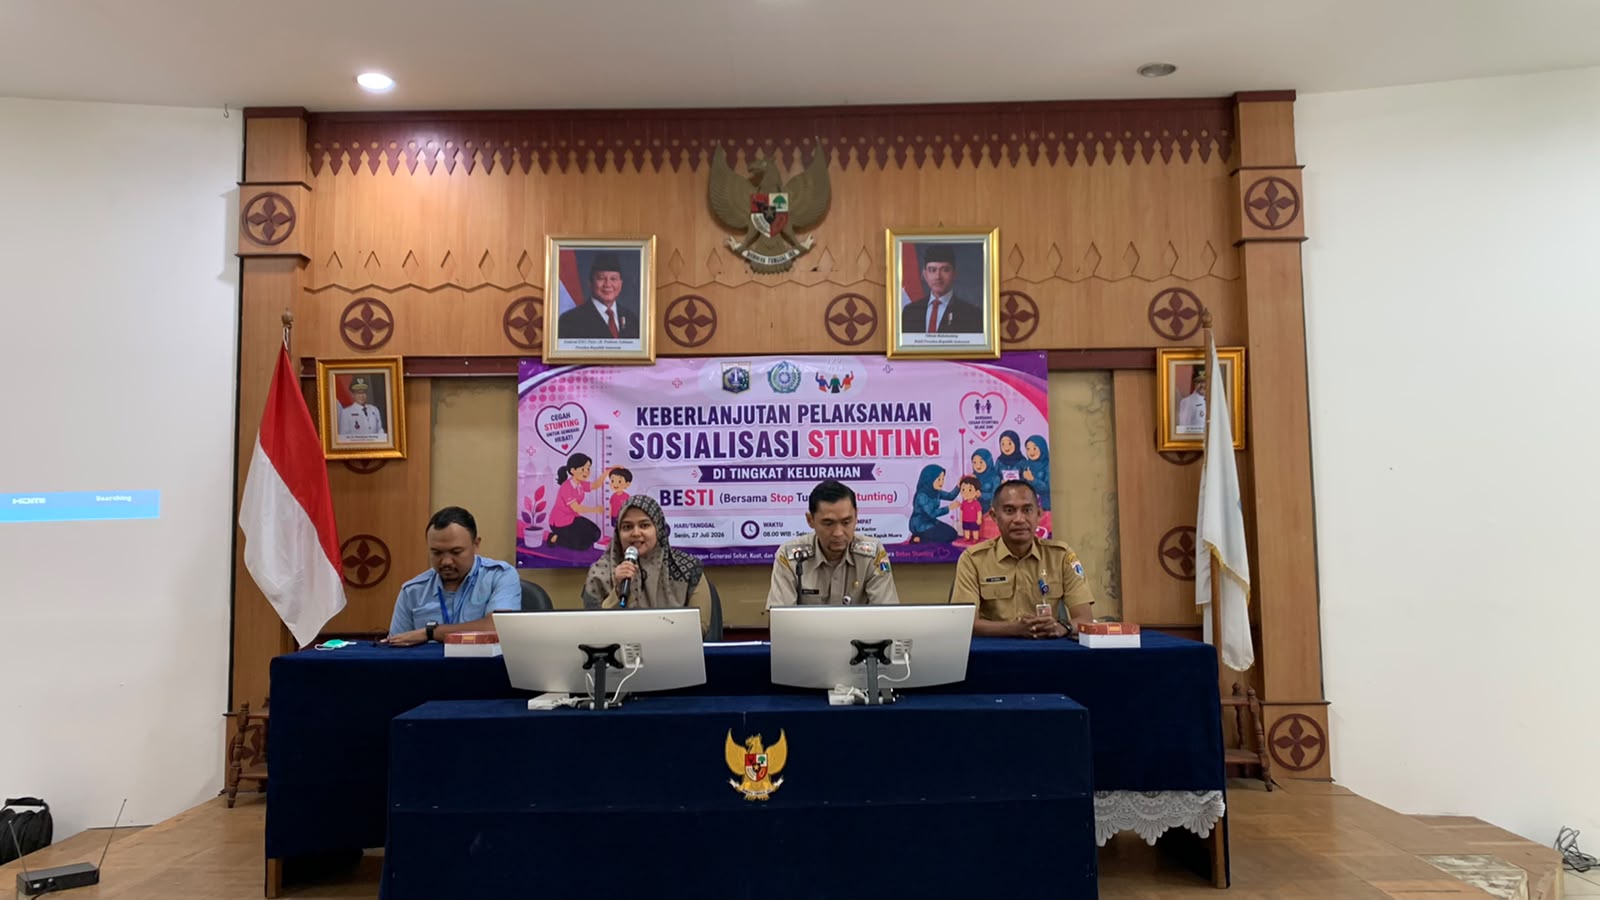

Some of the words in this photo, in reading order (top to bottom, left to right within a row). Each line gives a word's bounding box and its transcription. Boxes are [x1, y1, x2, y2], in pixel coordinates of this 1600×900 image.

[551, 412, 571, 421] CEGAH
[637, 405, 790, 426] KEBERLANJUTAN
[798, 403, 931, 424] PELAKSANAAN
[544, 418, 580, 431] STUNTING
[629, 430, 799, 460] SOSIALISASI
[808, 428, 939, 458] STUNTING
[713, 468, 726, 480] DI
[729, 467, 784, 479] TINGKAT
[787, 466, 861, 479] KELURAHAN
[12, 497, 46, 505] HDMI
[660, 489, 714, 507] BESTI
[719, 492, 767, 504] (Bersama
[770, 492, 794, 505] Stop
[857, 490, 898, 504] tunting)
[710, 552, 732, 560] Generasi
[732, 552, 749, 560] Sehat,
